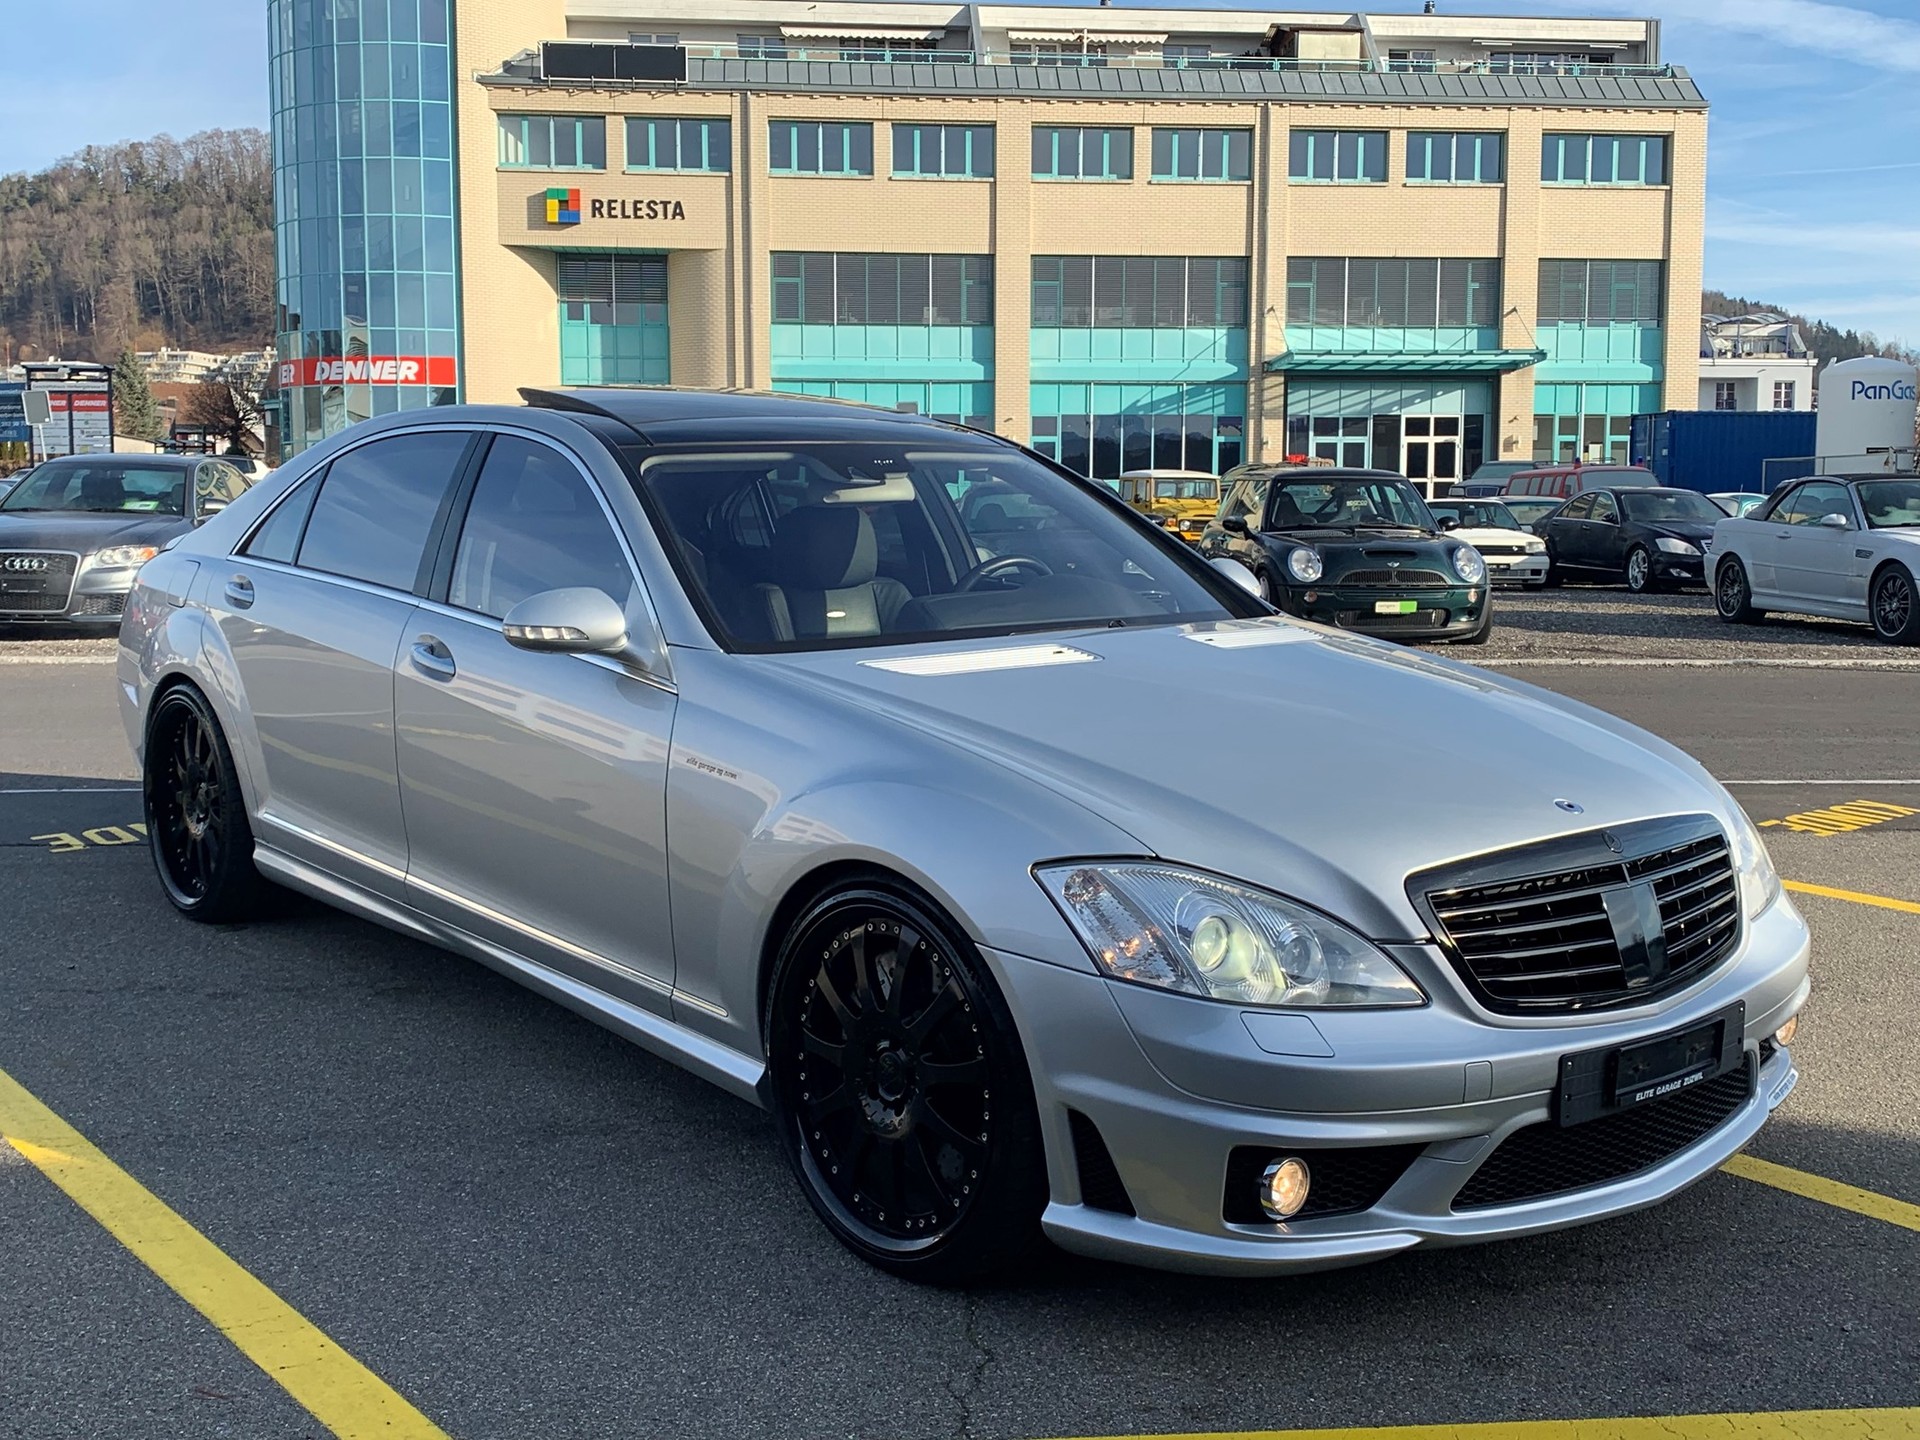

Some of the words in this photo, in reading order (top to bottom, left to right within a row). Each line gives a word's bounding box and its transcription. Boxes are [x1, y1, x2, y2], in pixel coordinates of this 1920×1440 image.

[591, 199, 685, 220] RELESTA
[314, 360, 419, 382] DENNER
[1852, 380, 1915, 400] PanGas
[1635, 1089, 1655, 1101] ELITE
[1656, 1080, 1682, 1095] GARAGE
